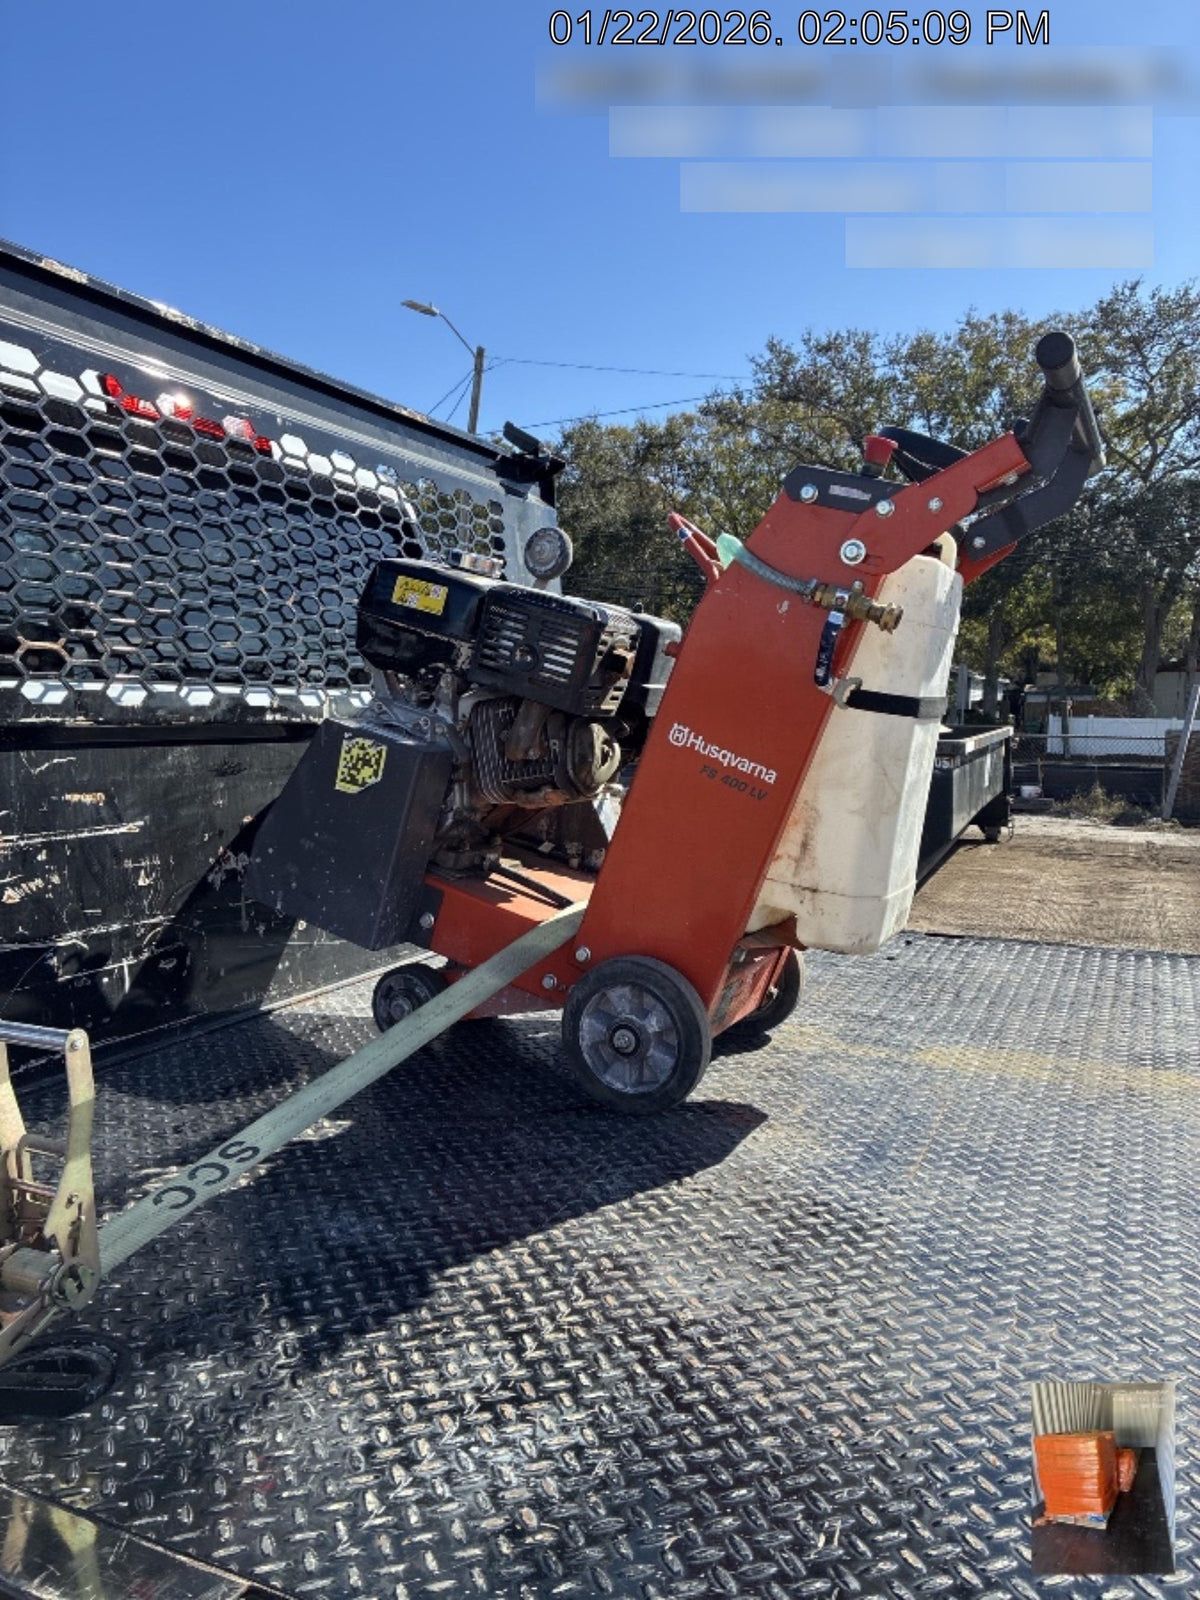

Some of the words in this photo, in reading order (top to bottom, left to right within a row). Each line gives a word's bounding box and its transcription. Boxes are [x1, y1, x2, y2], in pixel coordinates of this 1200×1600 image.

[686, 732, 778, 784] Husqvarna
[700, 764, 719, 780] FS
[722, 774, 748, 793] 400
[748, 786, 769, 801] LV
[152, 1140, 260, 1210] SCC
